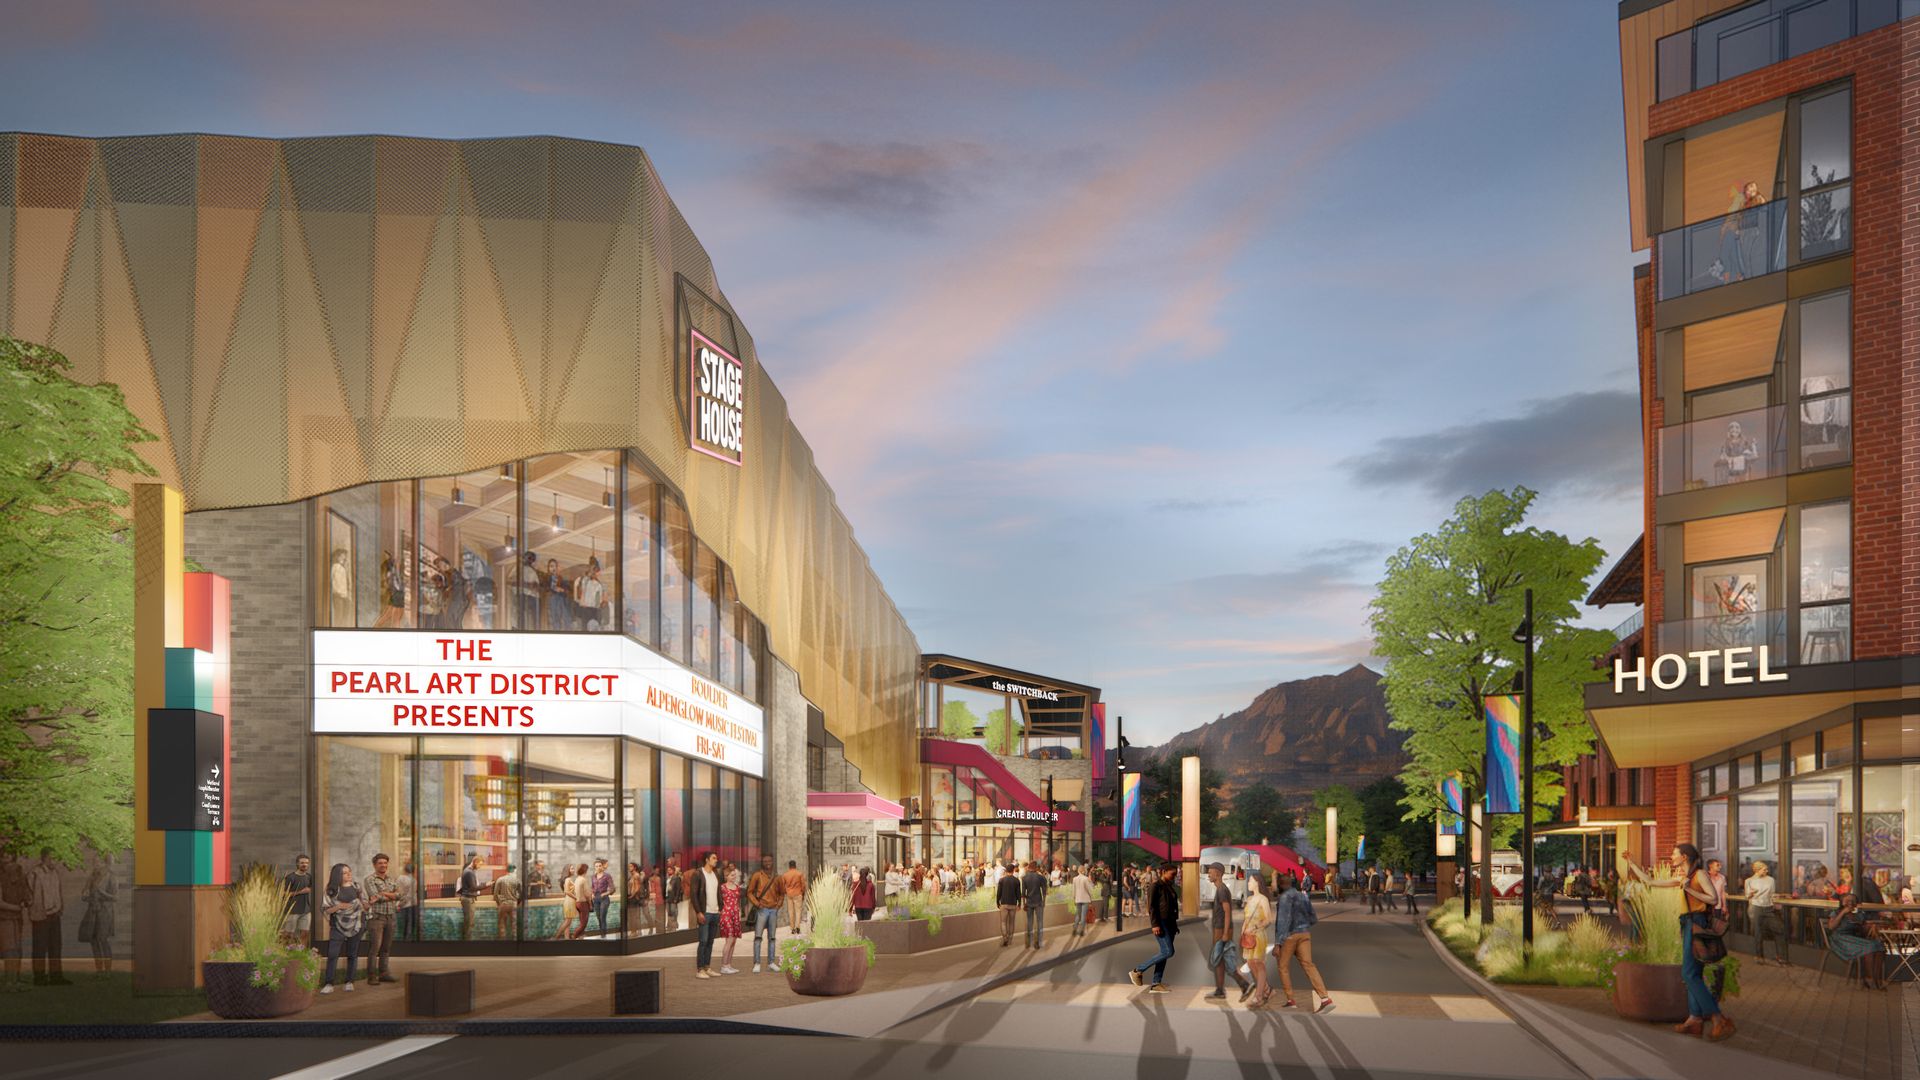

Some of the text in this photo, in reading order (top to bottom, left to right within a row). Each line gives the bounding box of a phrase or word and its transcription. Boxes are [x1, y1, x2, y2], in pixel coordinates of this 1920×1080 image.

[700, 347, 742, 409] STAGE
[700, 396, 742, 452] HOUSE
[436, 639, 492, 661] THE
[1614, 645, 1788, 694] HOTEL
[331, 671, 619, 696] PEARL ART DISTRICT
[691, 675, 728, 710] BOULDER
[992, 681, 1059, 701] the SWITCHBACK
[393, 704, 534, 727] PRESENTS
[646, 685, 704, 726] ALPENGLOW
[705, 711, 730, 736] MUSIC
[696, 735, 726, 760] FRI-SAT
[997, 809, 1025, 819] CREATE
[840, 835, 868, 846] EVENT
[840, 846, 862, 856] HALL
